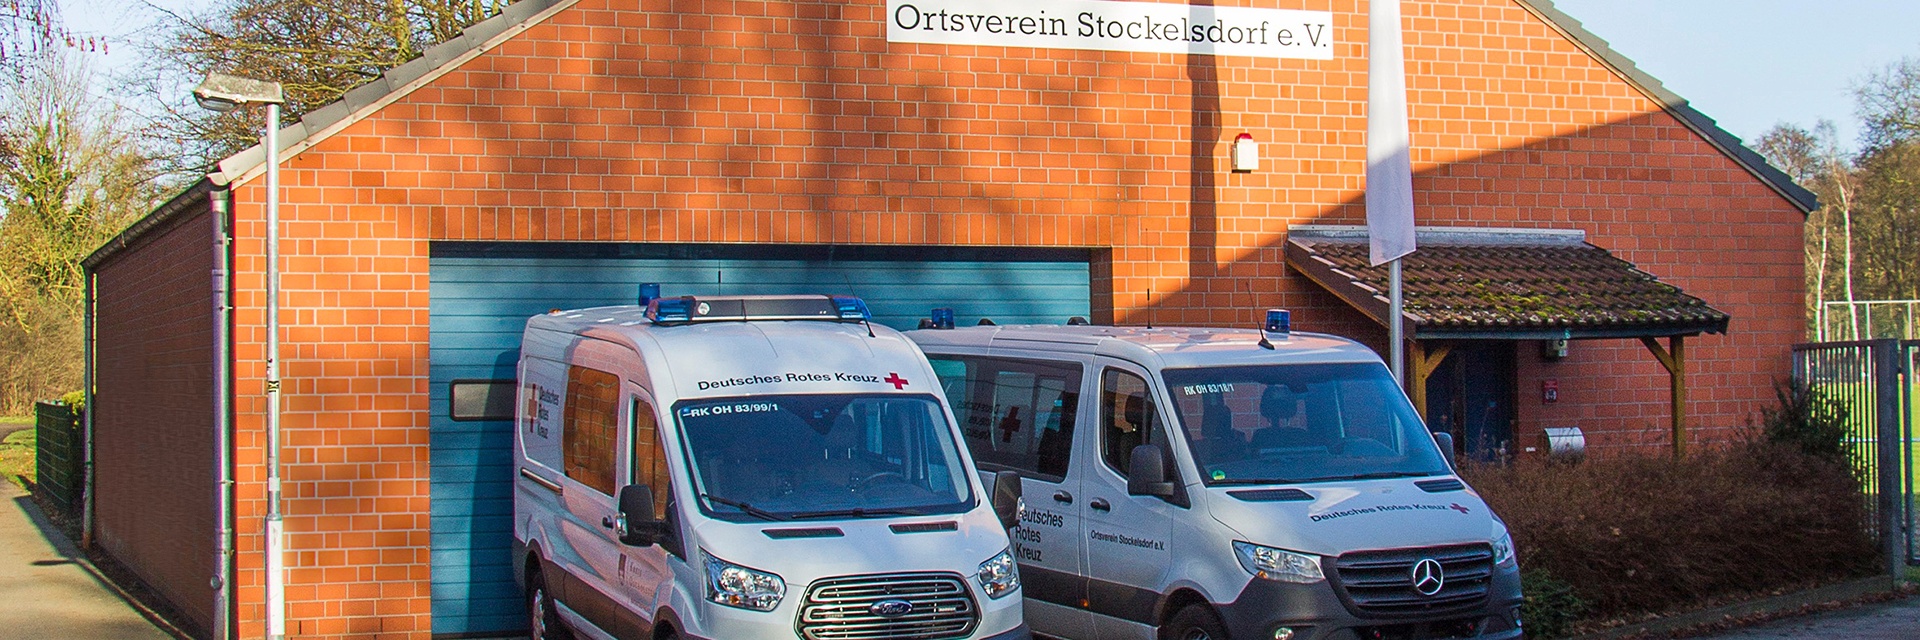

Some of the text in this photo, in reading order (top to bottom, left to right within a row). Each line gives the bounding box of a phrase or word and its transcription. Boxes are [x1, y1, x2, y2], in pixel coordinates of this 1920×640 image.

[894, 4, 1329, 48] Ortsverein Stockelsdorf e.V.
[698, 372, 879, 391] Deutsches Rotes Kreuz
[1184, 386, 1196, 396] RK
[1196, 385, 1208, 395] OH
[691, 403, 779, 418] RK OH 83/99/1
[1310, 503, 1448, 522] Deutsches Rotes Kreuz
[1015, 525, 1041, 543] Rotes
[1090, 530, 1118, 544] Ortsverein
[1118, 534, 1154, 550] Stockelsdorf
[1016, 543, 1042, 562] Kreuz
[881, 602, 904, 613] Ford
